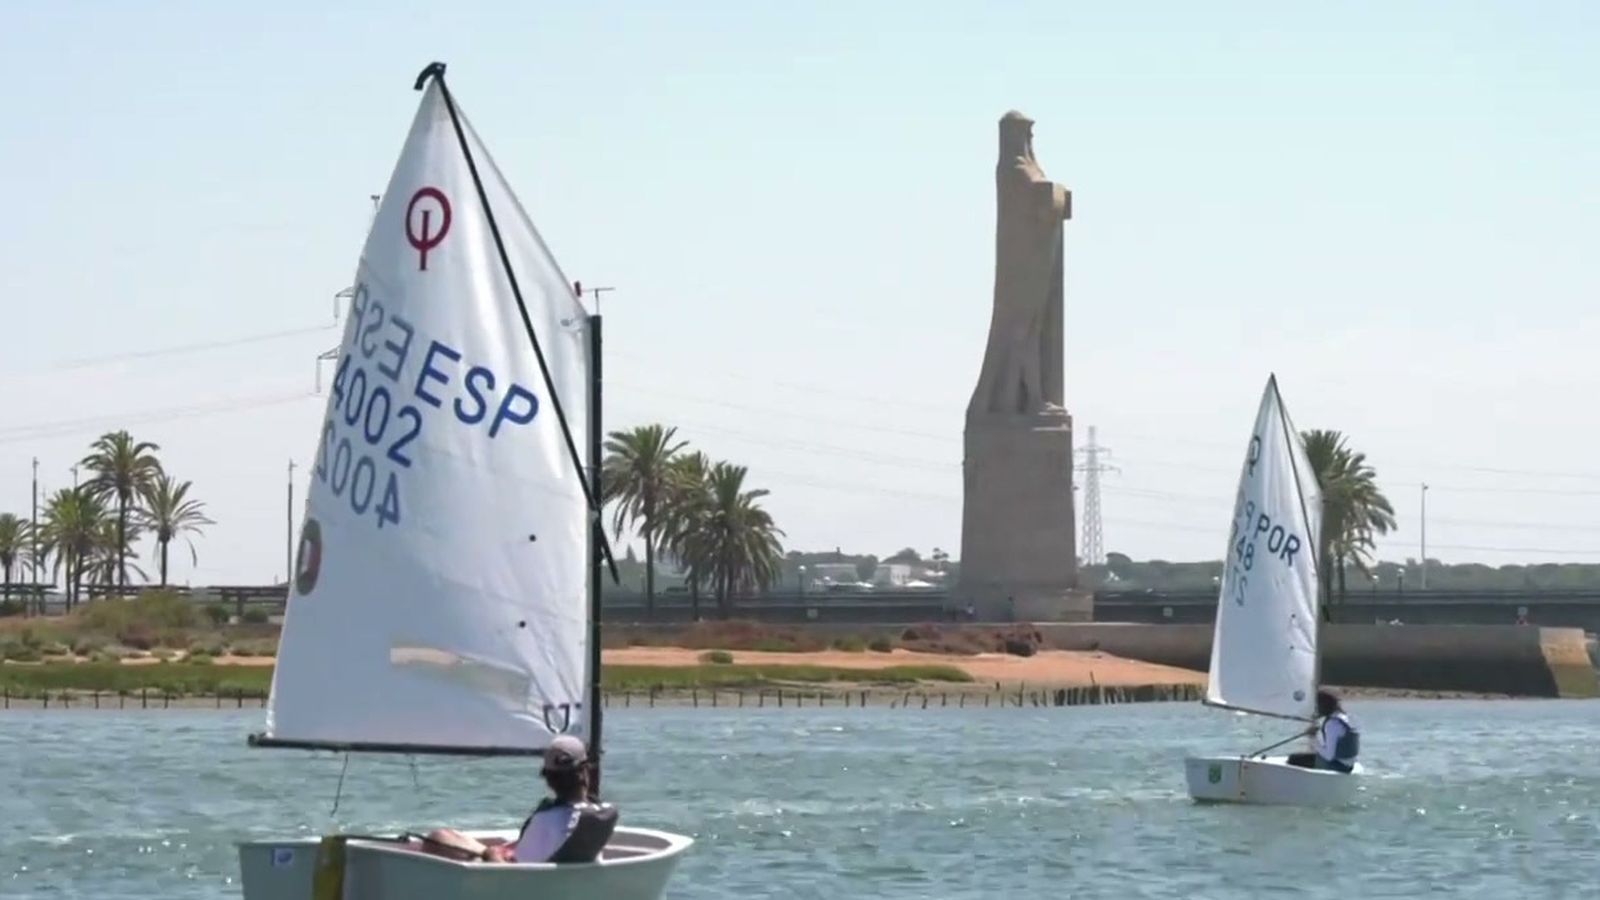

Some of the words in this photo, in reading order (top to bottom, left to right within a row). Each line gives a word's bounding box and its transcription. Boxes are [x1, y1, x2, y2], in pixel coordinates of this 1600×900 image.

[333, 354, 423, 468] 4002
[413, 340, 539, 439] ESP
[1253, 513, 1301, 567] POR
